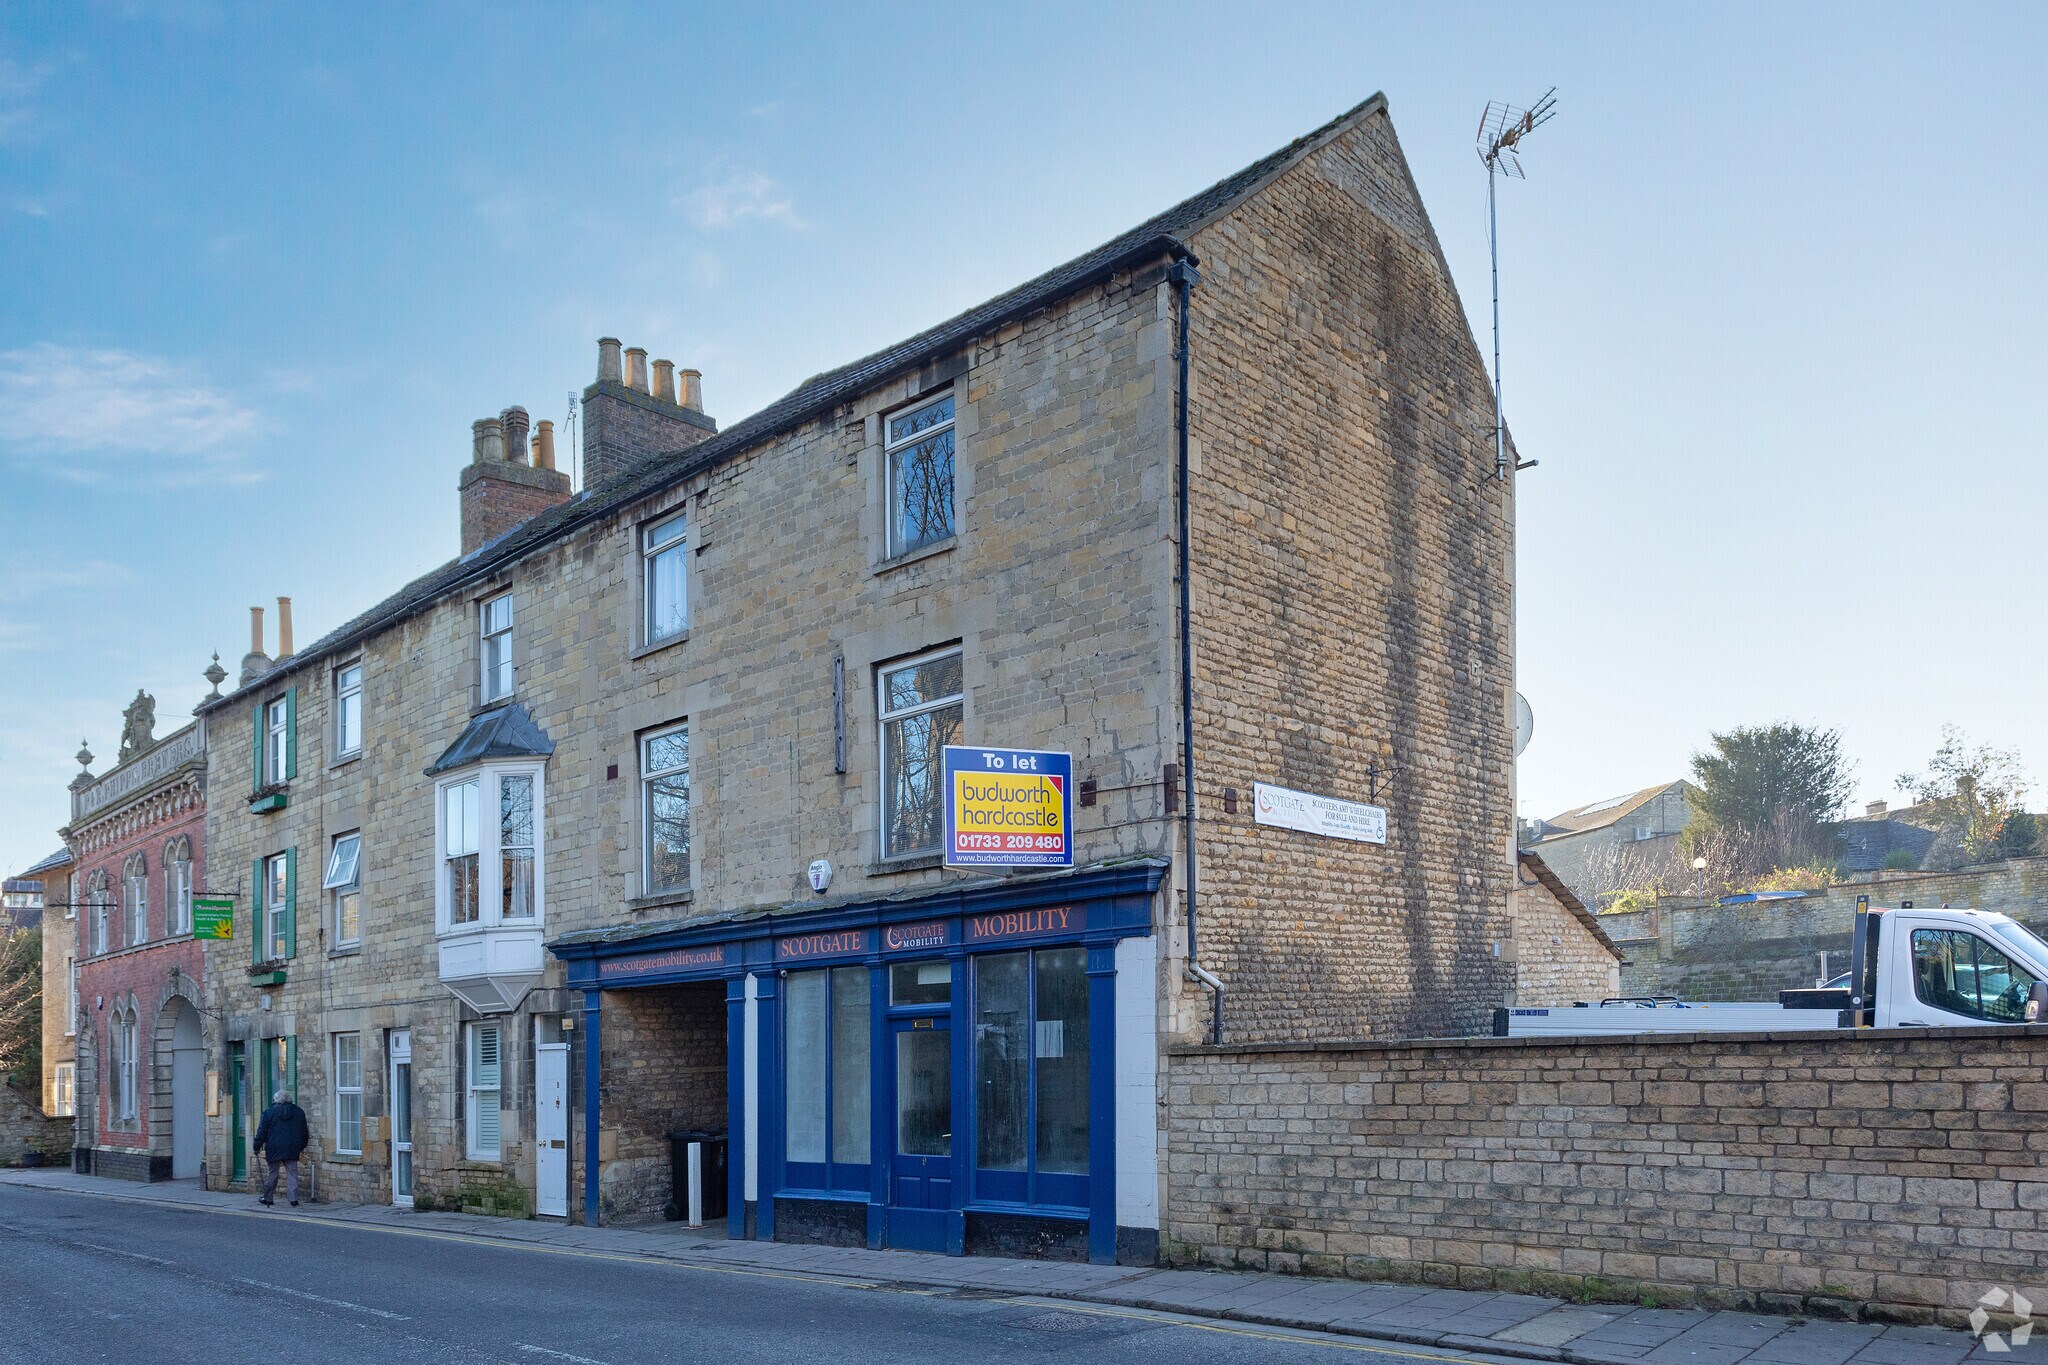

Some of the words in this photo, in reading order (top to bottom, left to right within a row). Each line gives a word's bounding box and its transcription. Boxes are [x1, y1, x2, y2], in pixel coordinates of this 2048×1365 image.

[982, 753, 1005, 768] To
[1012, 755, 1037, 770] let
[962, 776, 1050, 804] budworth
[1262, 793, 1305, 811] SCOTGATE
[1312, 799, 1338, 811] SCOOTERS
[1339, 804, 1349, 813] AND
[1348, 806, 1383, 819] WHEELCHAIRS
[963, 804, 1058, 827] hardcastle
[1325, 811, 1336, 820] FOR
[1336, 812, 1347, 821] SALE
[1348, 815, 1359, 824] AND
[1359, 817, 1370, 826] HIRE
[958, 834, 1001, 848] 01733
[1006, 836, 1033, 849] 209
[1035, 836, 1061, 849] 480
[956, 854, 1065, 864] www.budworthhardcastle.com
[973, 907, 1071, 938] MOBILITY
[893, 924, 944, 941] SCOTGATE
[781, 931, 861, 957] SCOTGATE
[903, 936, 944, 948] MOBILITY
[600, 946, 723, 973] www.scotgatemobility.co.uk
